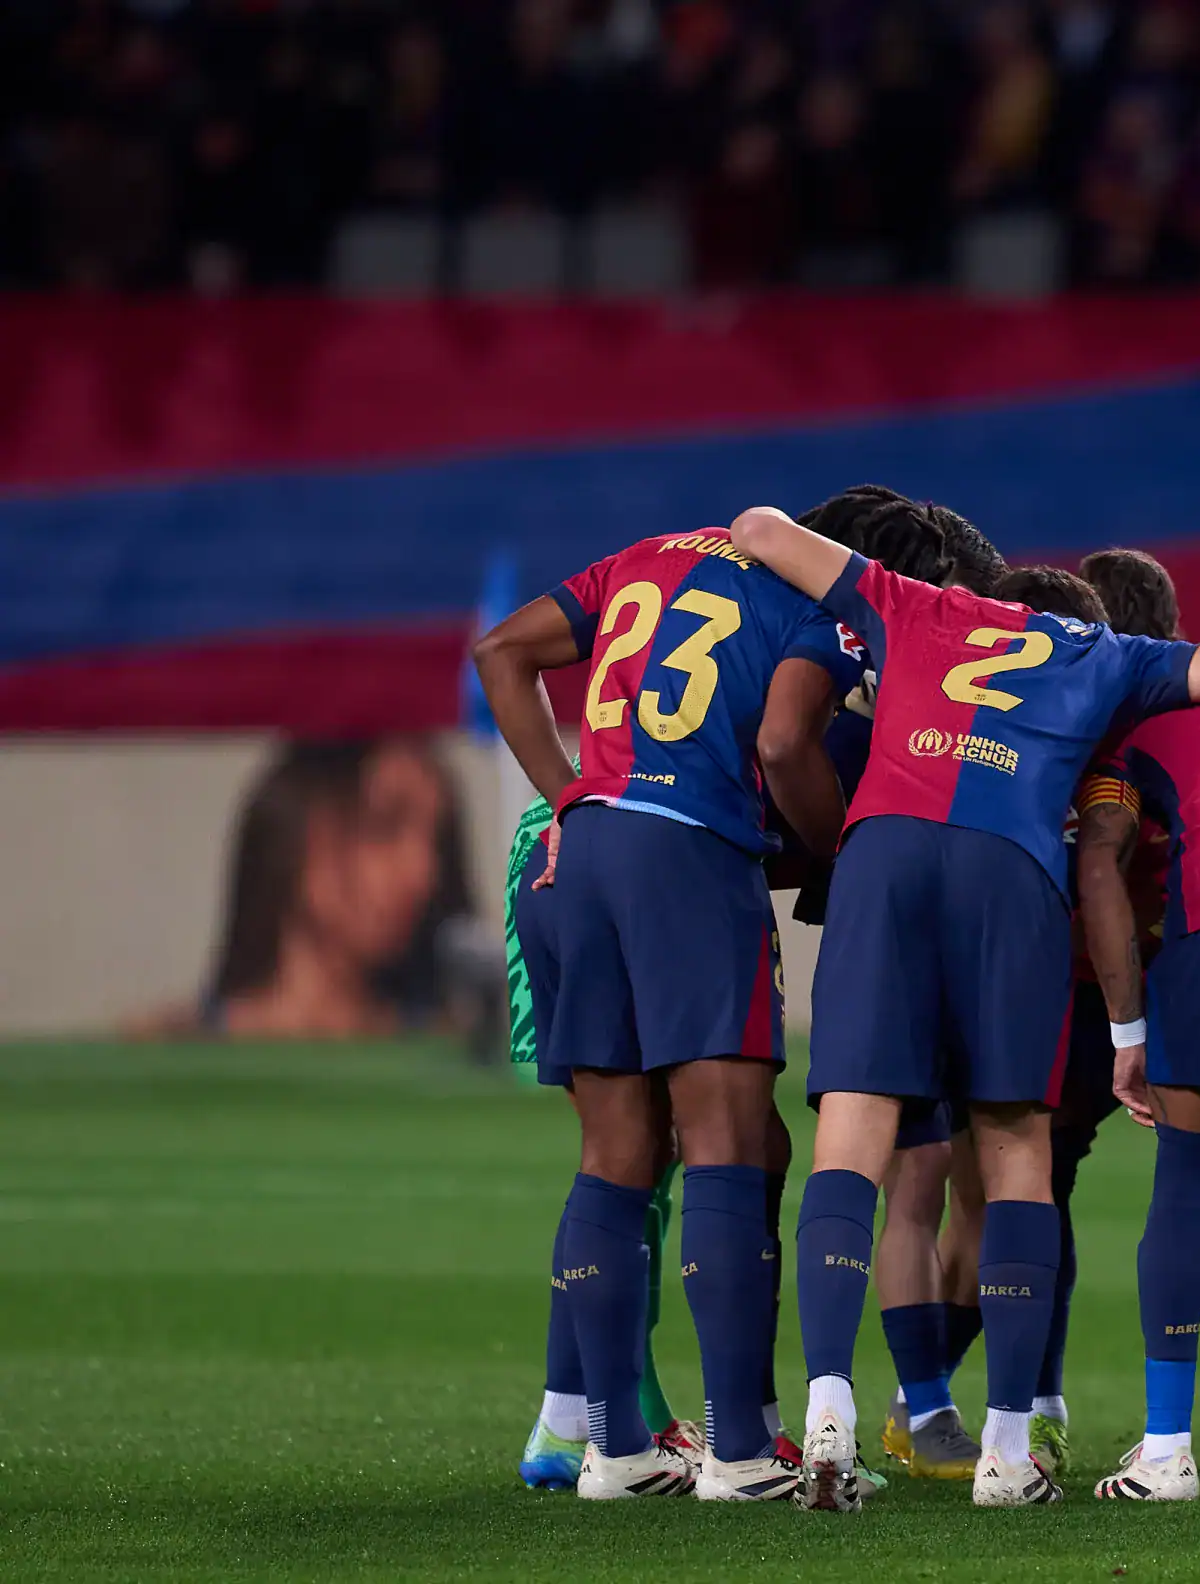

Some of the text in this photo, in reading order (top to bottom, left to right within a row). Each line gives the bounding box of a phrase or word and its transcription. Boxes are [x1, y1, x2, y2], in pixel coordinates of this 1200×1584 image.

[585, 580, 742, 742] 23
[940, 627, 1054, 713] 2
[952, 745, 1017, 772] ACNUR
[956, 733, 1019, 762] UNHCR
